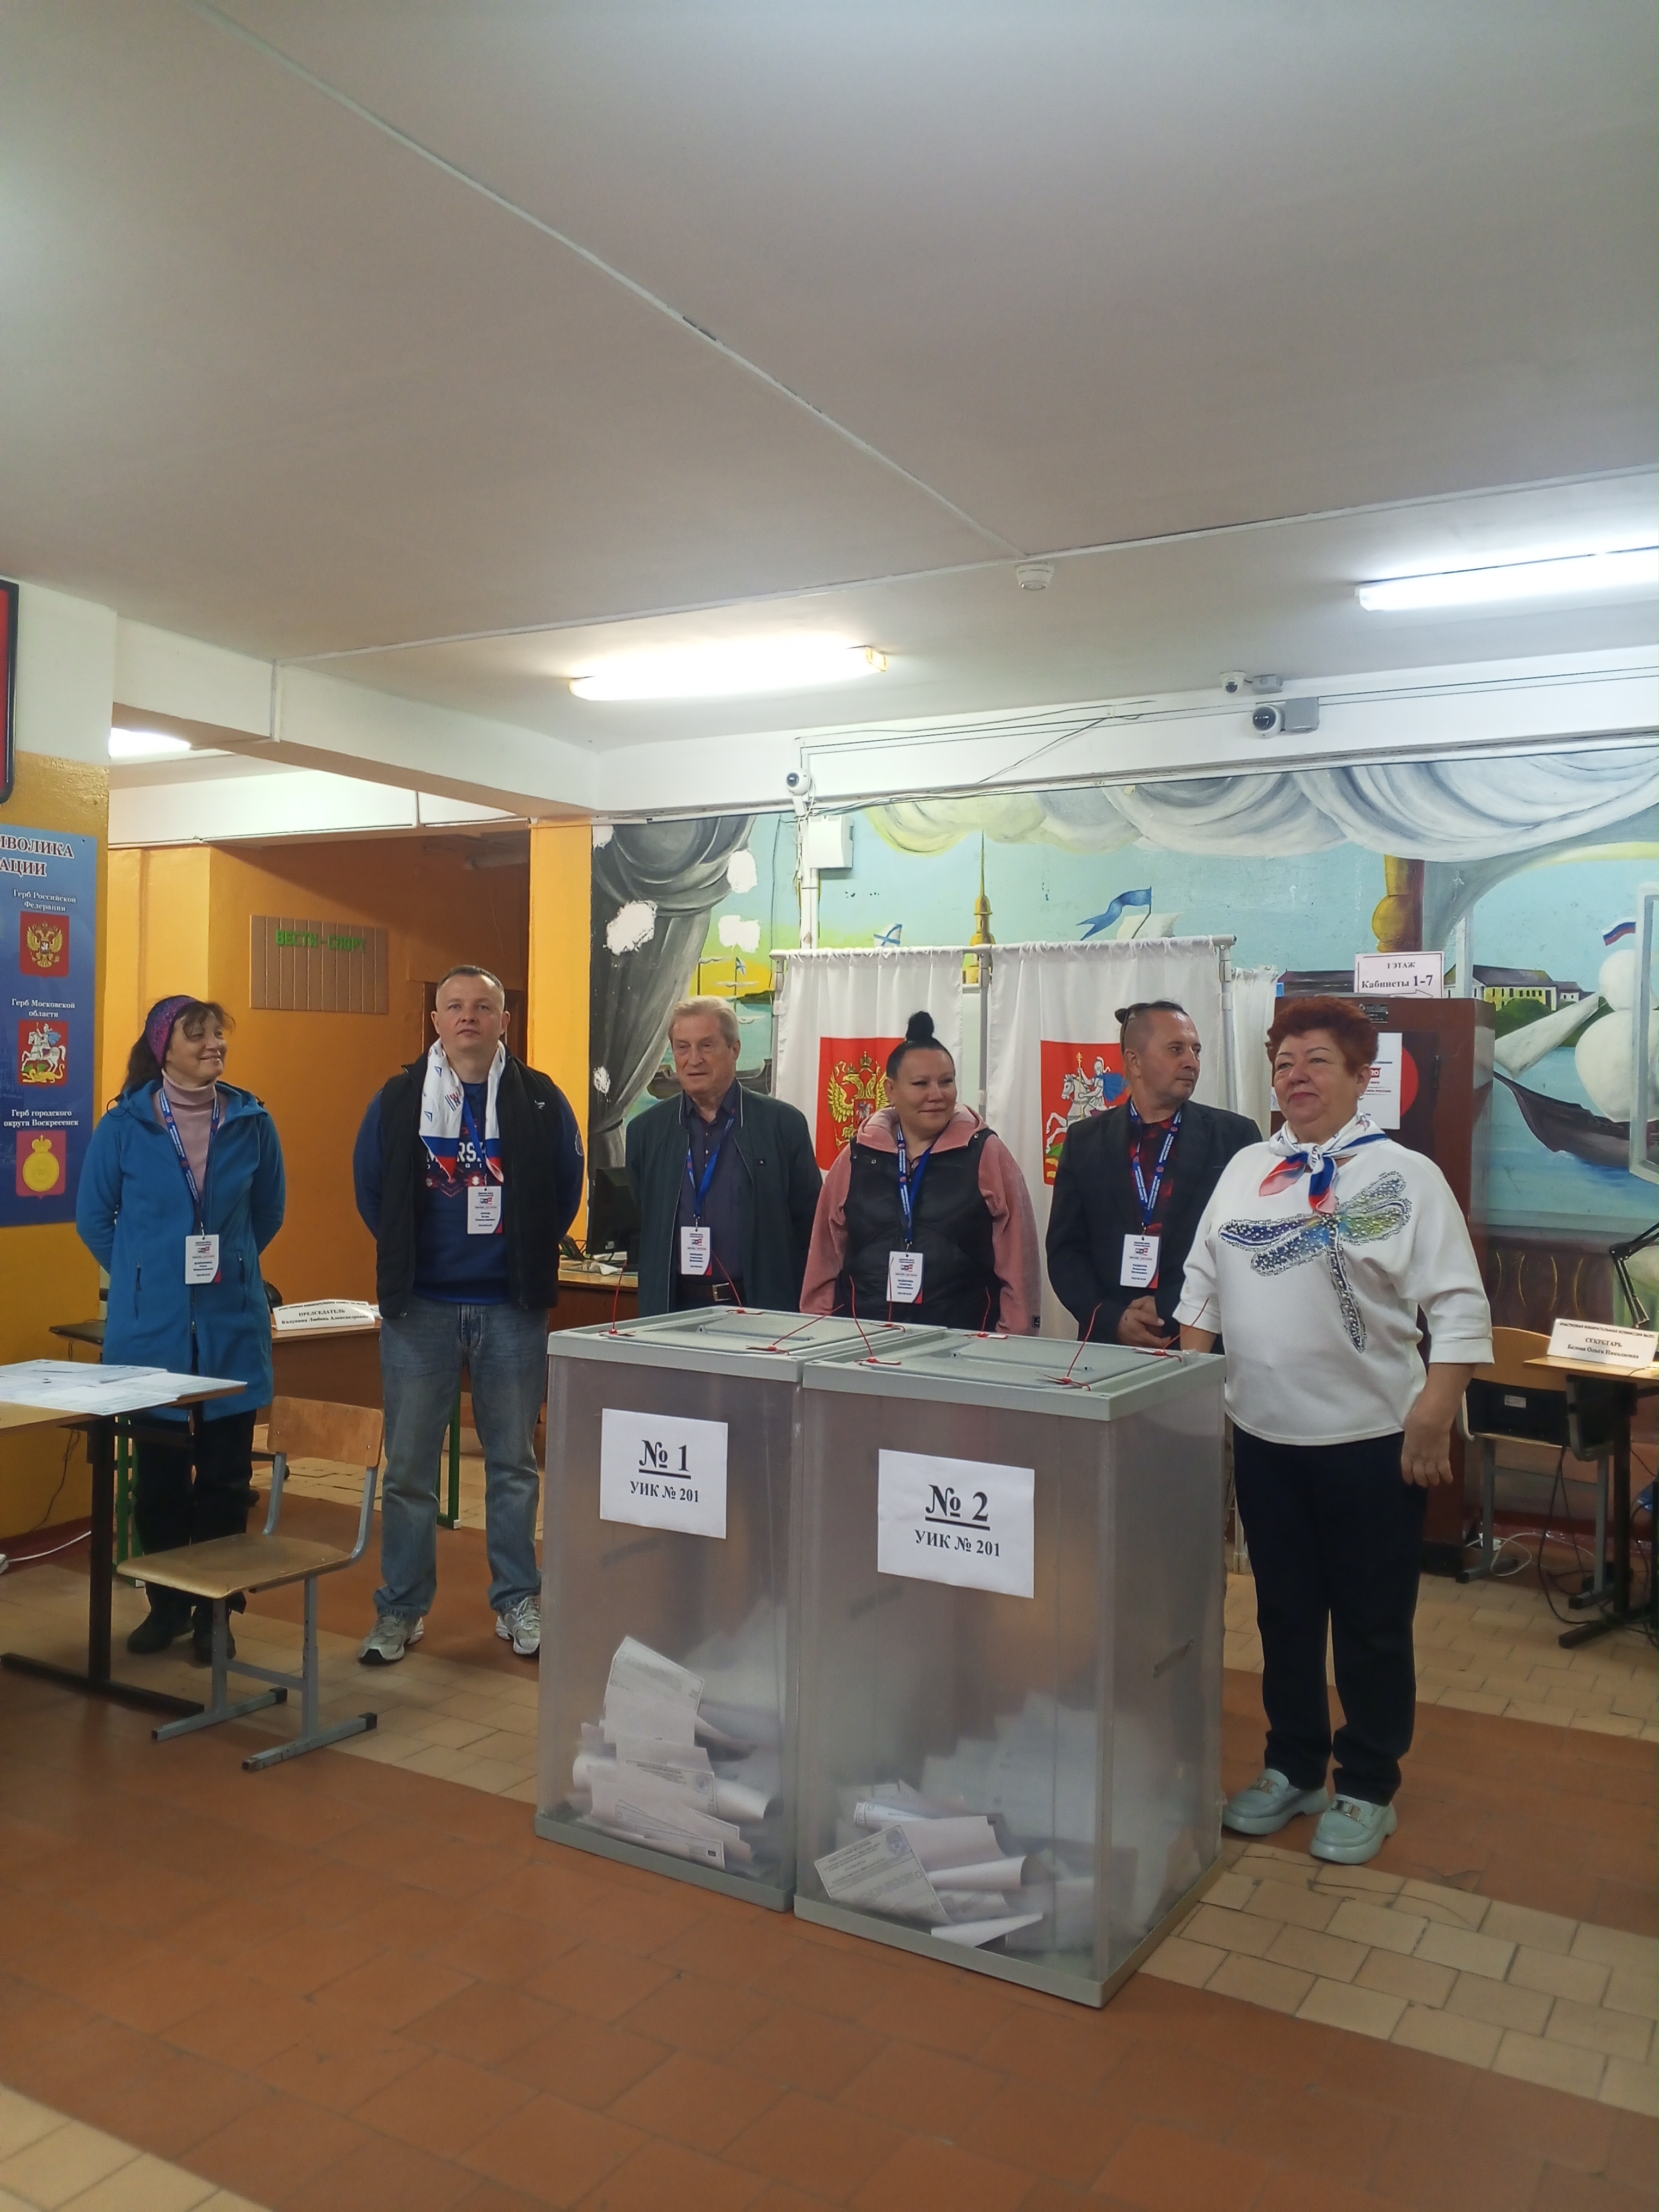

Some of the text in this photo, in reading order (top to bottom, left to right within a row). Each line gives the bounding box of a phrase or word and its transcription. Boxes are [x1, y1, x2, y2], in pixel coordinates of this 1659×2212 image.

[14, 889, 76, 903] Герб Российской
[24, 900, 66, 912] Федерации
[1362, 975, 1433, 988] Кабинеты 1-7
[11, 998, 75, 1009] Герб Московской
[11, 1109, 72, 1119] Герб городского
[4, 1119, 79, 1128] округа Воскресенск
[1586, 1337, 1622, 1348] СЕКРЕТАРЬ
[639, 1439, 689, 1472] № 1
[630, 1480, 699, 1503] УИК № 201
[925, 1484, 988, 1522] № 2
[914, 1529, 1000, 1557] УИК № 201
